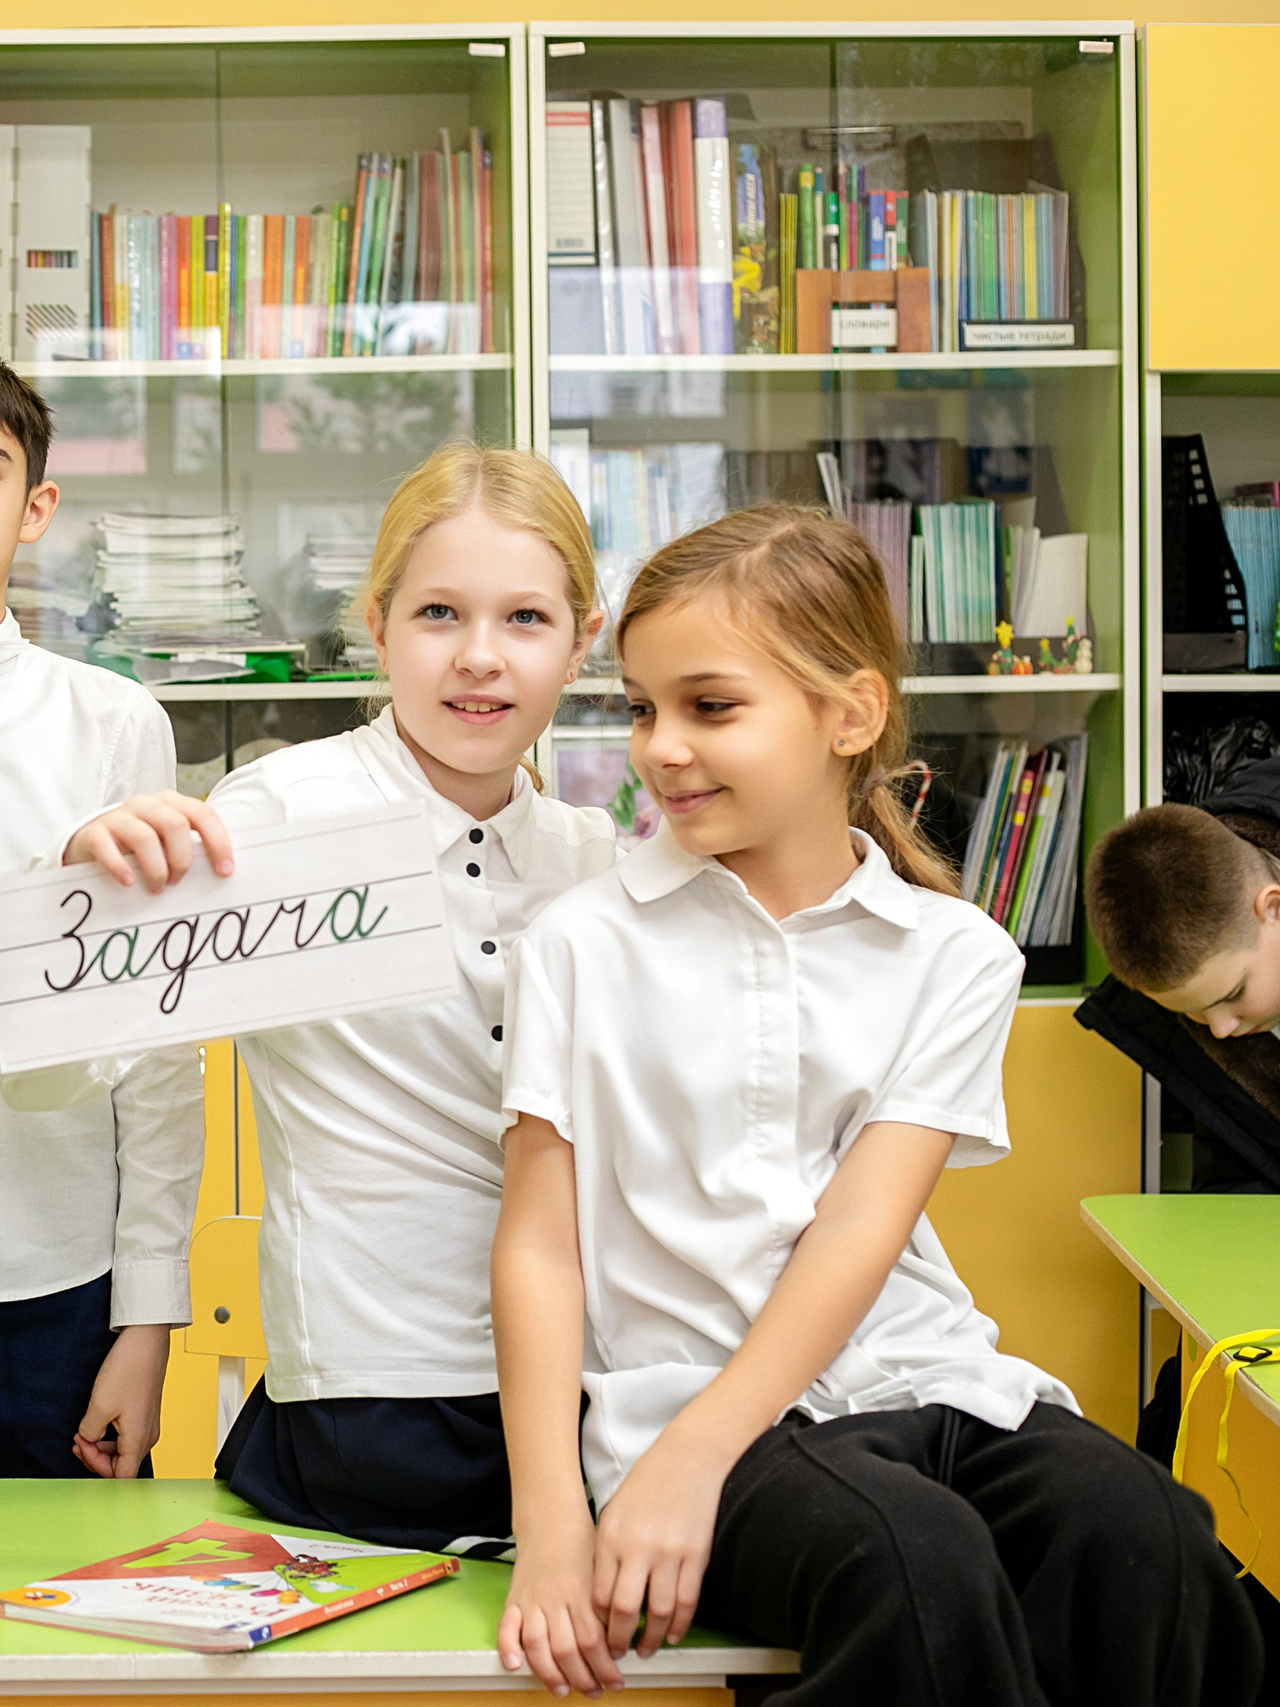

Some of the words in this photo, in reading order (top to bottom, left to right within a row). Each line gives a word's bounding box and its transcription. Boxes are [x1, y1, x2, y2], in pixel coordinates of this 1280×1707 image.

[973, 330, 1015, 341] чистые
[1019, 330, 1067, 342] тетради
[44, 884, 388, 1014] Задача
[121, 1537, 255, 1569] 4
